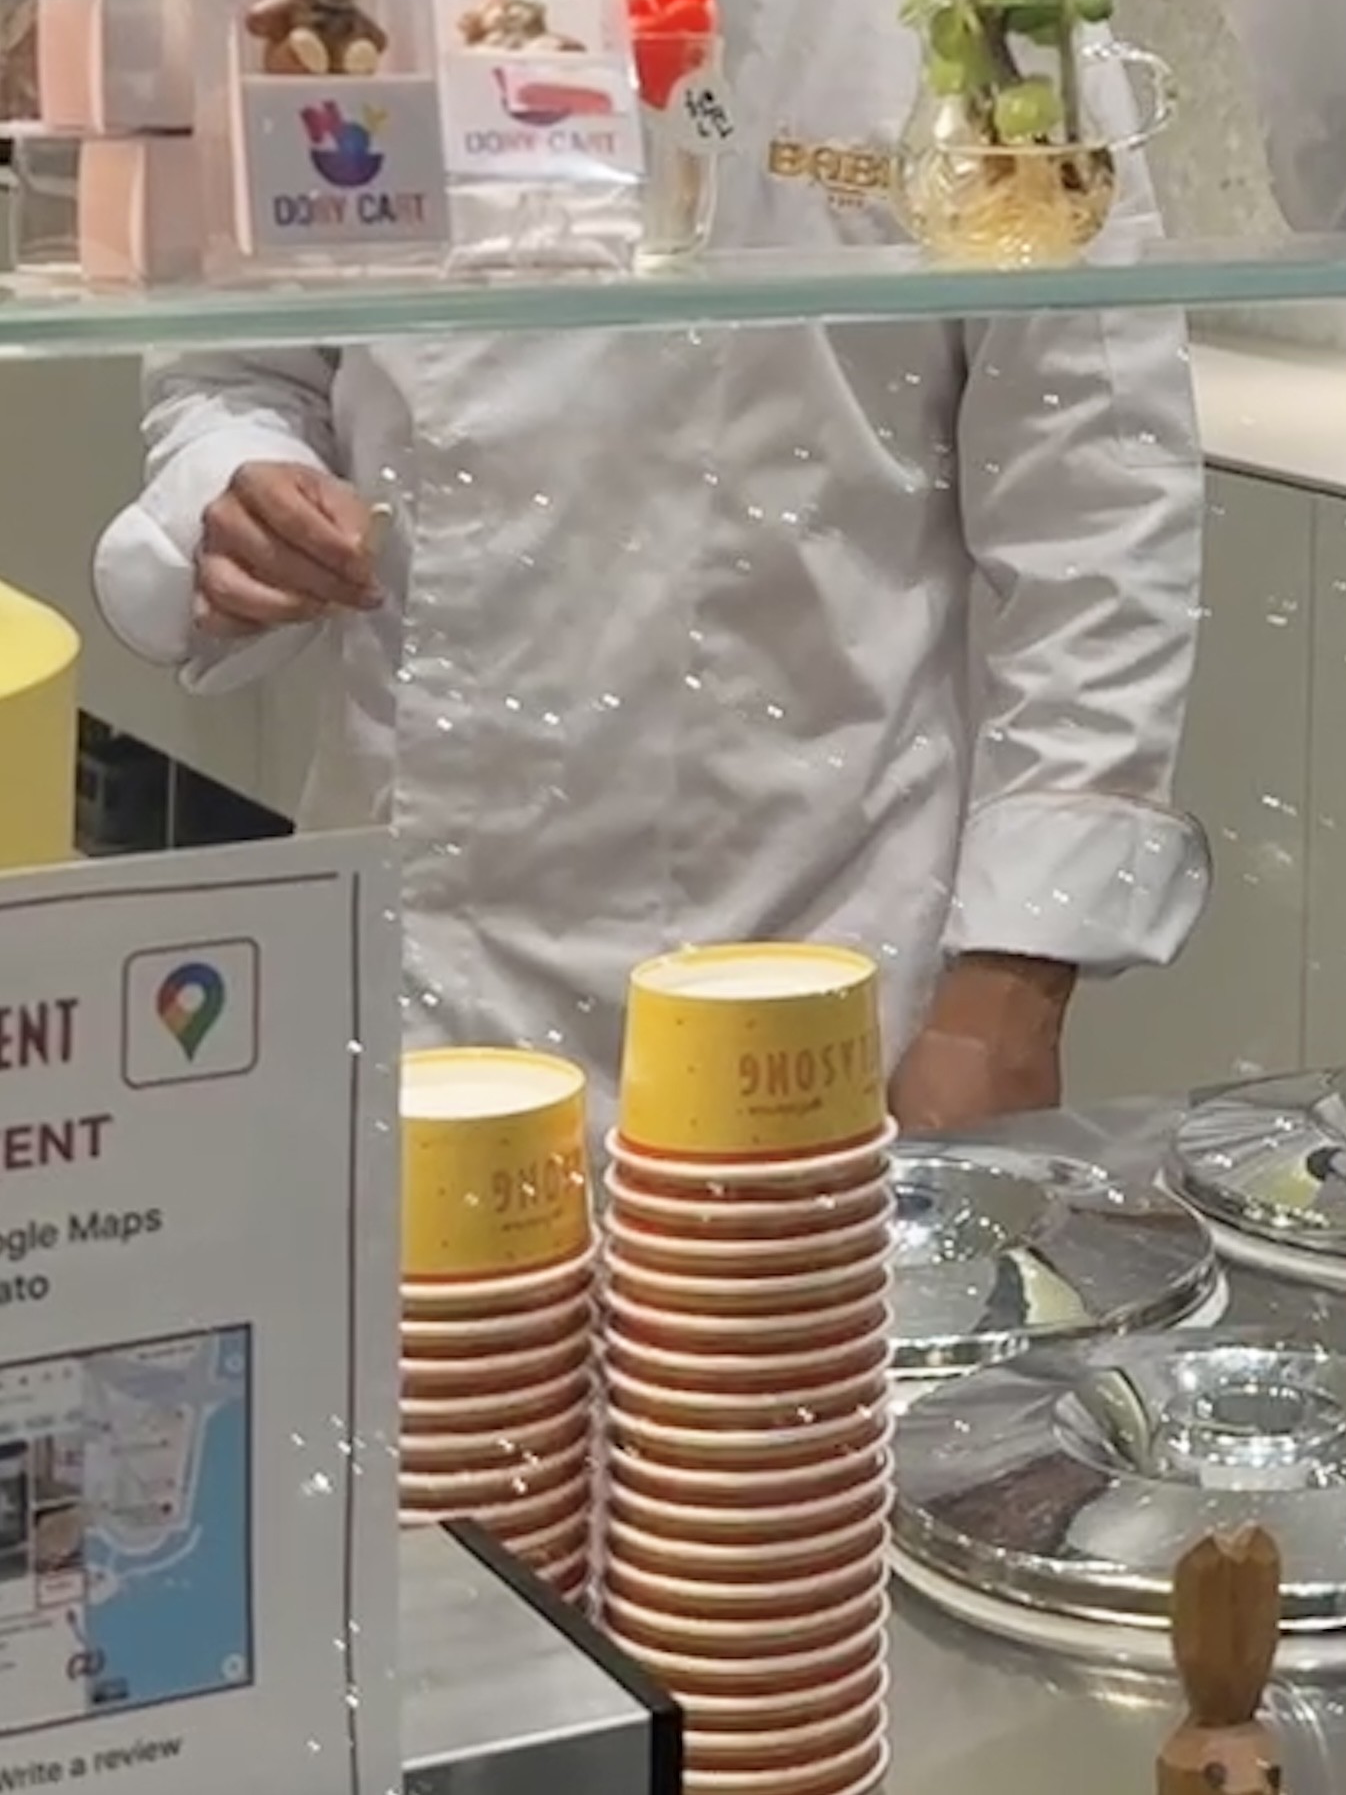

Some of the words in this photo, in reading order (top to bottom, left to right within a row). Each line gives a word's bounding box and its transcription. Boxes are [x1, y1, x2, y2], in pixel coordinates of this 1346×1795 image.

[68, 1208, 163, 1245] Maps
[70, 1757, 87, 1778] a
[94, 1736, 182, 1773] review
